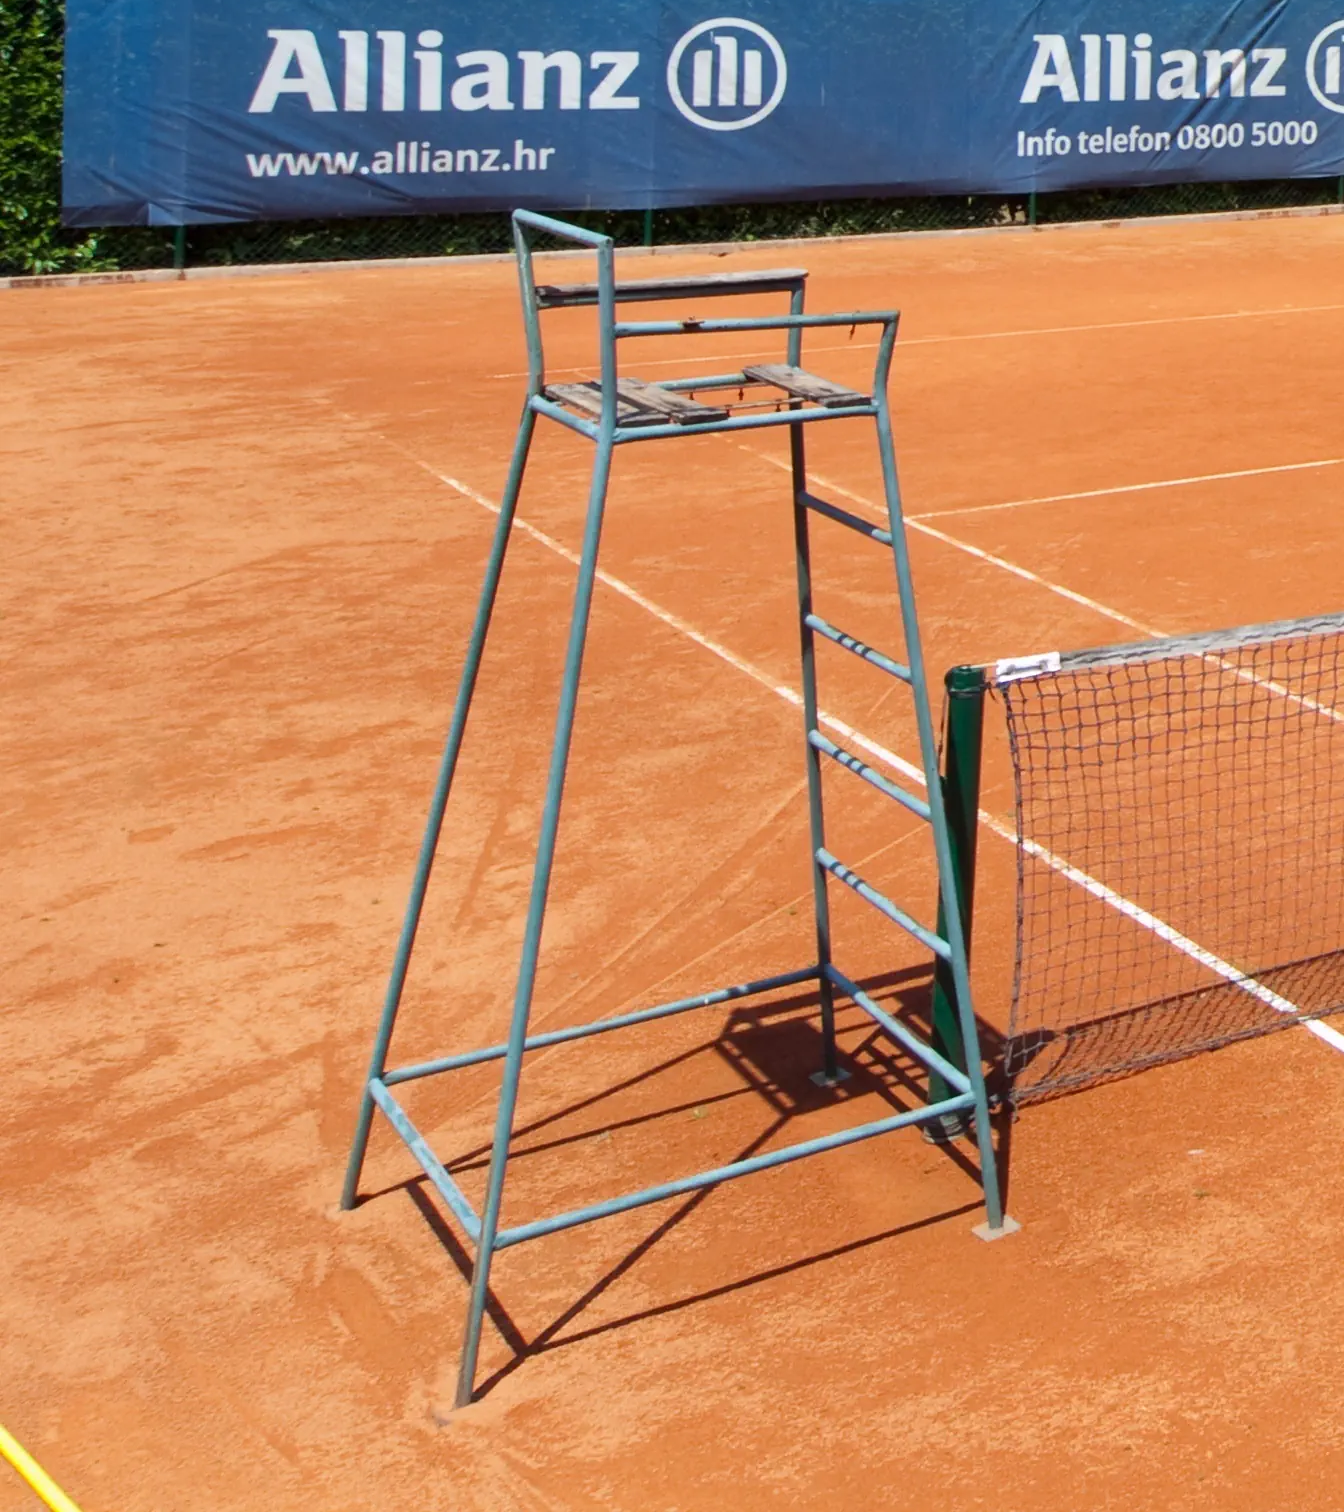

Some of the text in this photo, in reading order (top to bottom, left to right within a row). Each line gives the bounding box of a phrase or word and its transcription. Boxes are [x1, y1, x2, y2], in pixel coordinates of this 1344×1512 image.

[248, 29, 640, 113] Allianz
[1019, 32, 1287, 104] Allianz
[247, 139, 555, 178] www.allianz.hr
[1016, 120, 1318, 157] Info telefon 0800 5000
